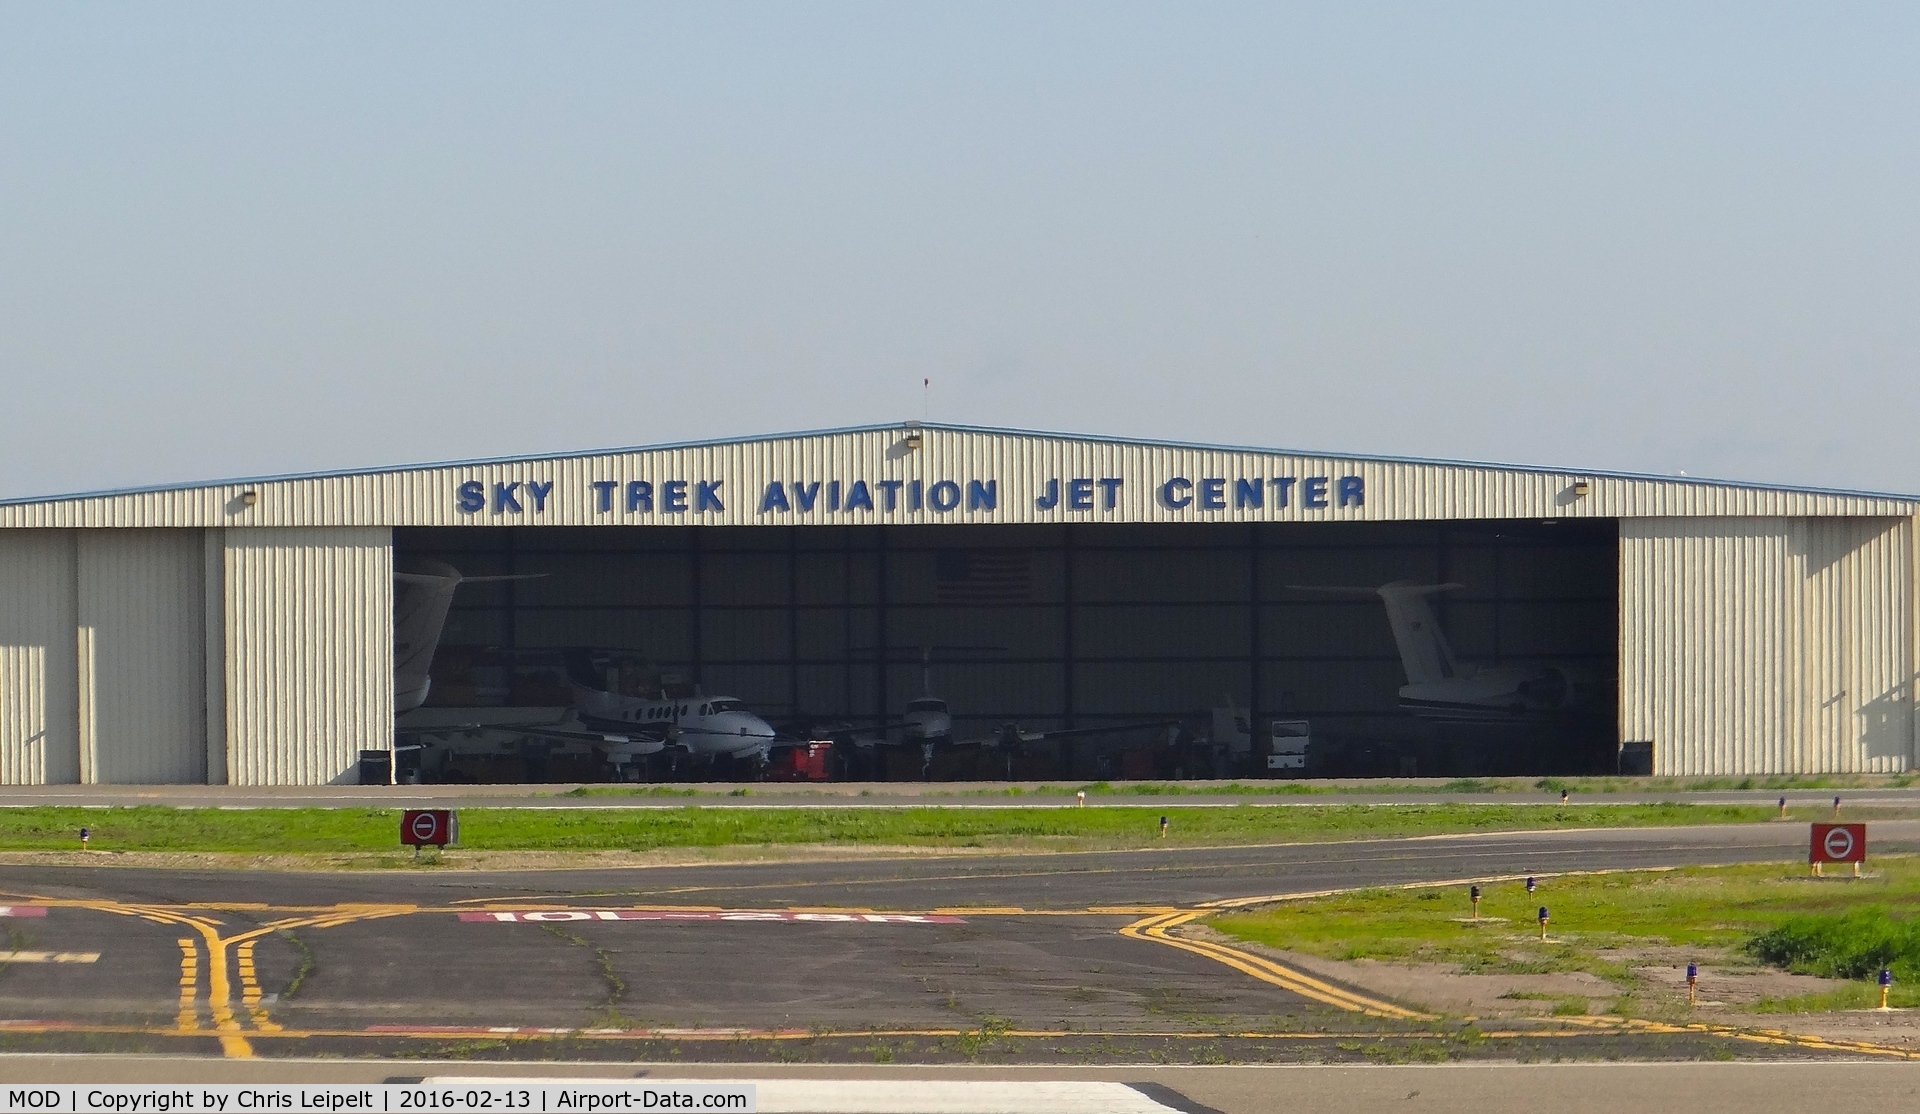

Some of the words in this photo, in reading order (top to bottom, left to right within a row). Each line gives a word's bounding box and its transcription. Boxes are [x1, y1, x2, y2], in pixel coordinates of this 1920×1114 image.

[460, 481, 553, 513] SKY
[594, 480, 725, 512] TREK
[764, 480, 997, 512] AVIATION
[1038, 478, 1122, 510] JET
[1163, 476, 1365, 509] CENTER
